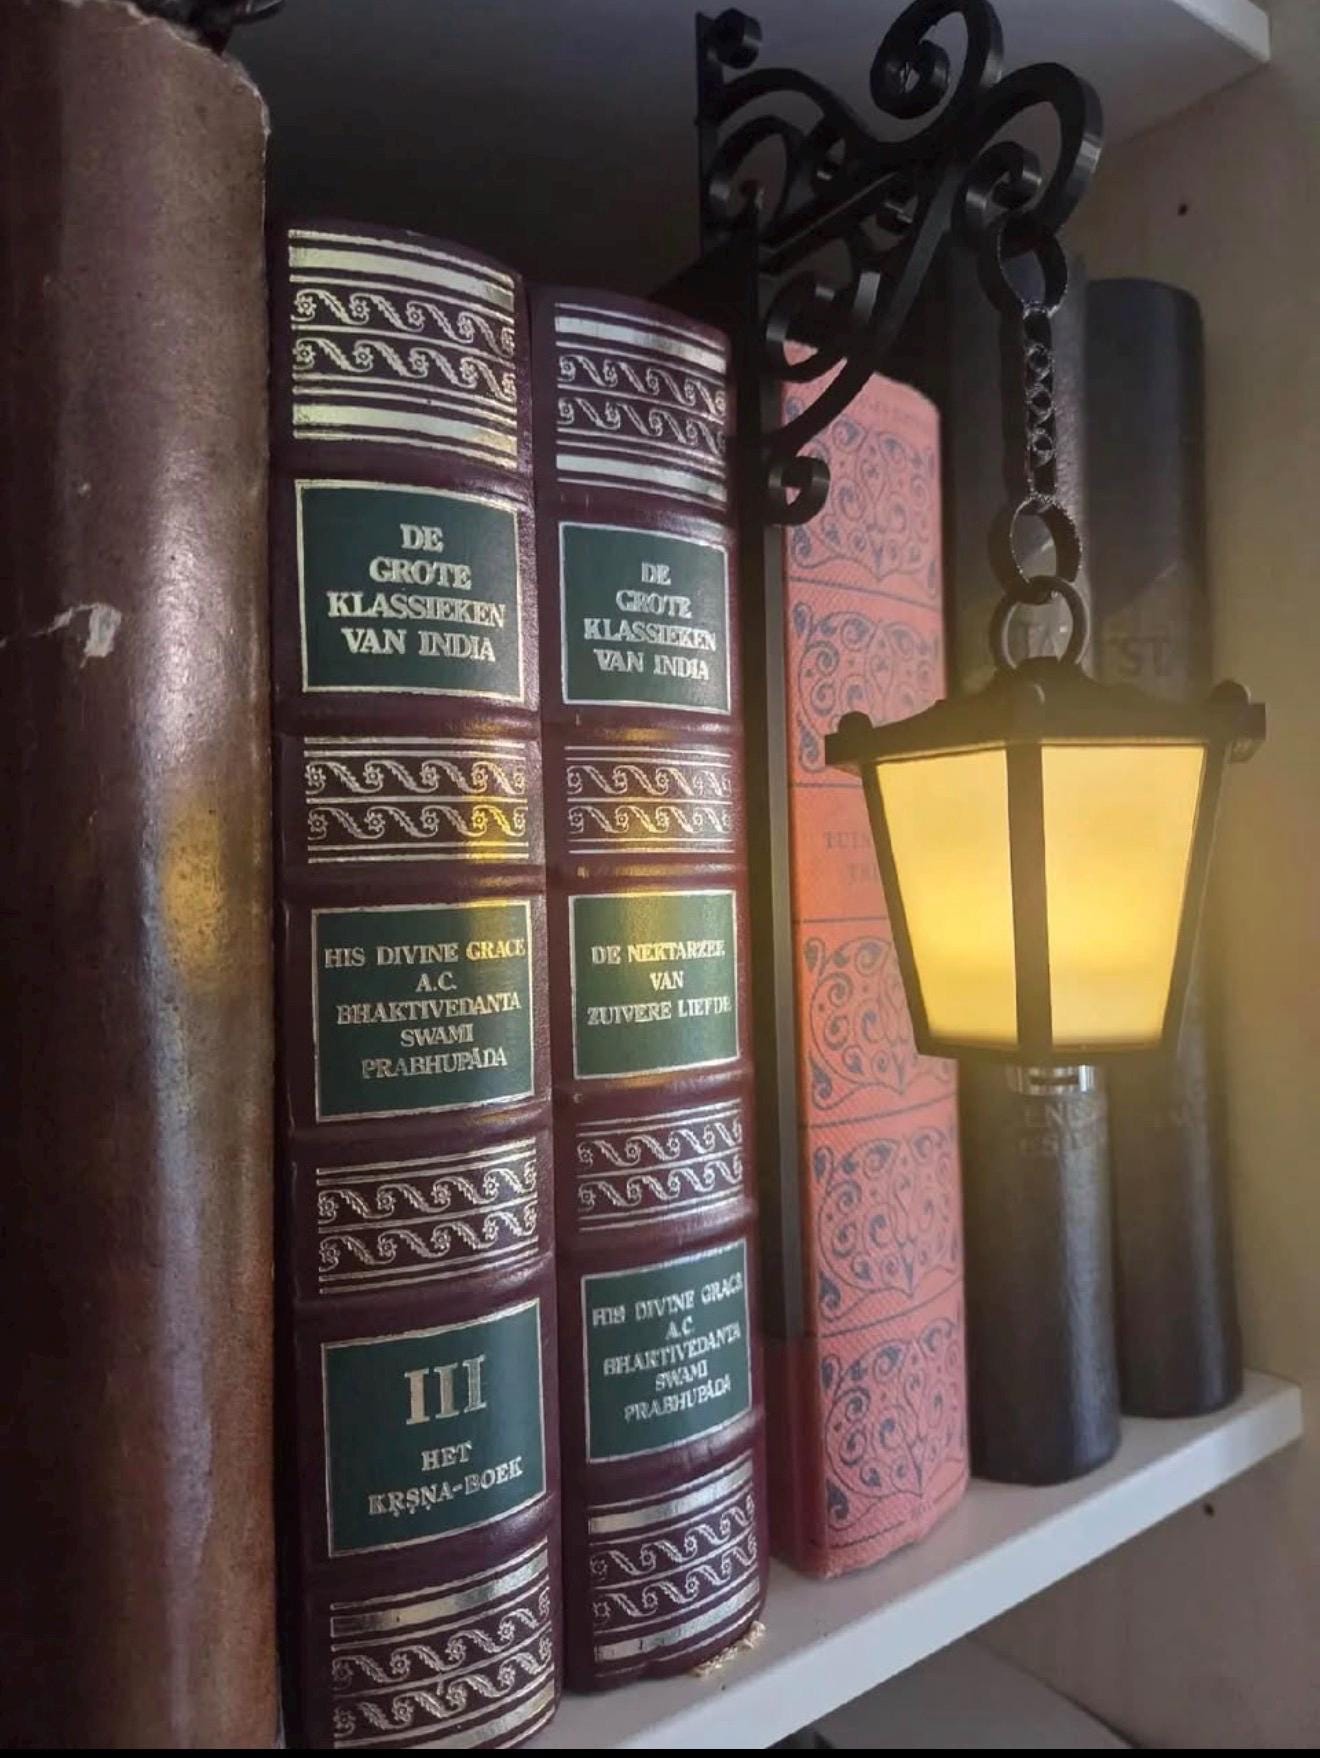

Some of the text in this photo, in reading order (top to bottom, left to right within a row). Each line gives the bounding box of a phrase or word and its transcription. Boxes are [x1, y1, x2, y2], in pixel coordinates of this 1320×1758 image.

[400, 523, 444, 553] DE
[369, 556, 472, 591] GROTE
[641, 561, 671, 585] DE
[326, 590, 506, 628] KLASSIEKEN
[616, 589, 692, 619] GROTE
[341, 627, 496, 662] VAN INDIA
[584, 617, 716, 651] KLASSIEKEN
[593, 648, 709, 680] VAN INDIA
[324, 938, 526, 968] HIS DIVINE GRACE
[591, 940, 726, 965] DE NEKTARZEE
[415, 971, 457, 992] A.C.
[649, 970, 684, 991] VAN
[336, 992, 521, 1025] BHAKTIVEDANTA
[586, 995, 732, 1026] ZUIVERE LIEFDE
[400, 1023, 474, 1047] SWAMI
[592, 1272, 743, 1326] HIS DIVINE GRACE
[603, 1322, 741, 1376] BHAKTIVEDANTA
[404, 1354, 487, 1426] III
[655, 1359, 709, 1391] SWAMI
[421, 1440, 472, 1472] HET
